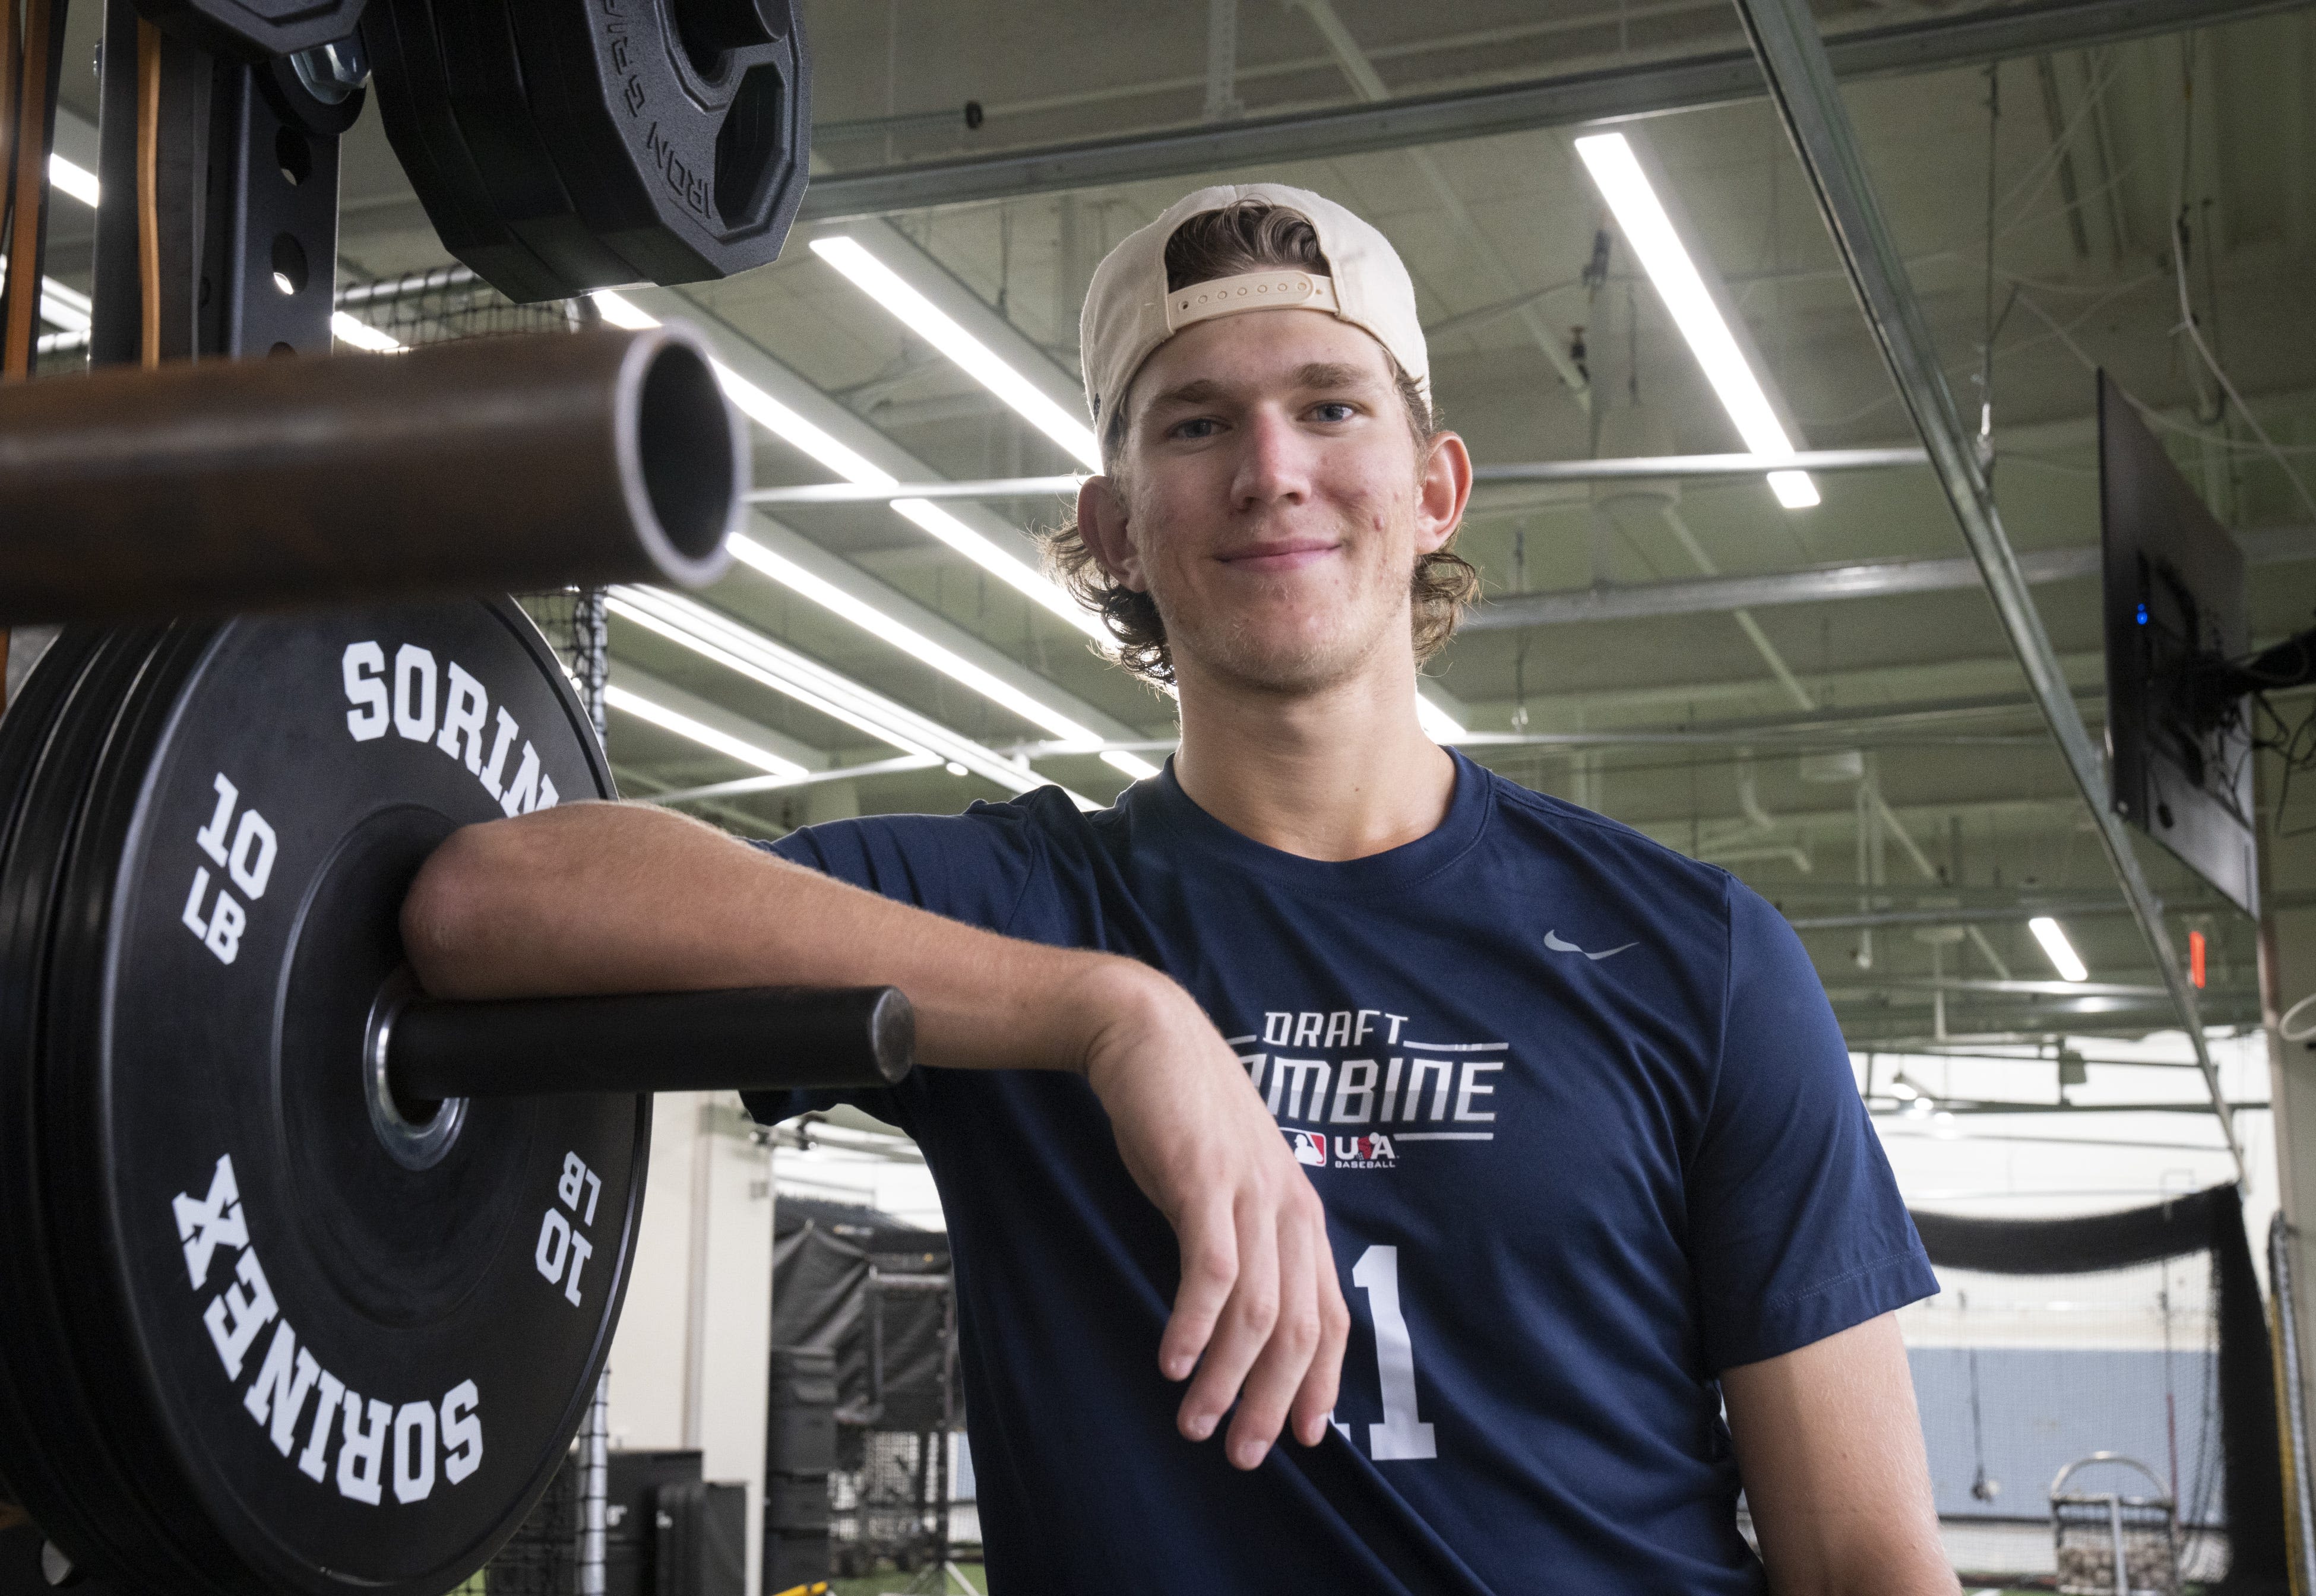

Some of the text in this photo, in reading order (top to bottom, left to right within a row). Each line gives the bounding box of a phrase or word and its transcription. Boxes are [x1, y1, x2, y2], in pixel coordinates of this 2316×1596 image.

[647, 121, 711, 219] IRON
[197, 772, 277, 901] 10
[182, 866, 246, 965] LB
[1263, 1009, 1409, 1048] DRAFT
[558, 1151, 602, 1227] LB
[1334, 1160, 1396, 1169] BASEBALL
[535, 1207, 593, 1307] 10
[172, 1153, 483, 1506] SORINEX
[1328, 1244, 1438, 1461] 1
